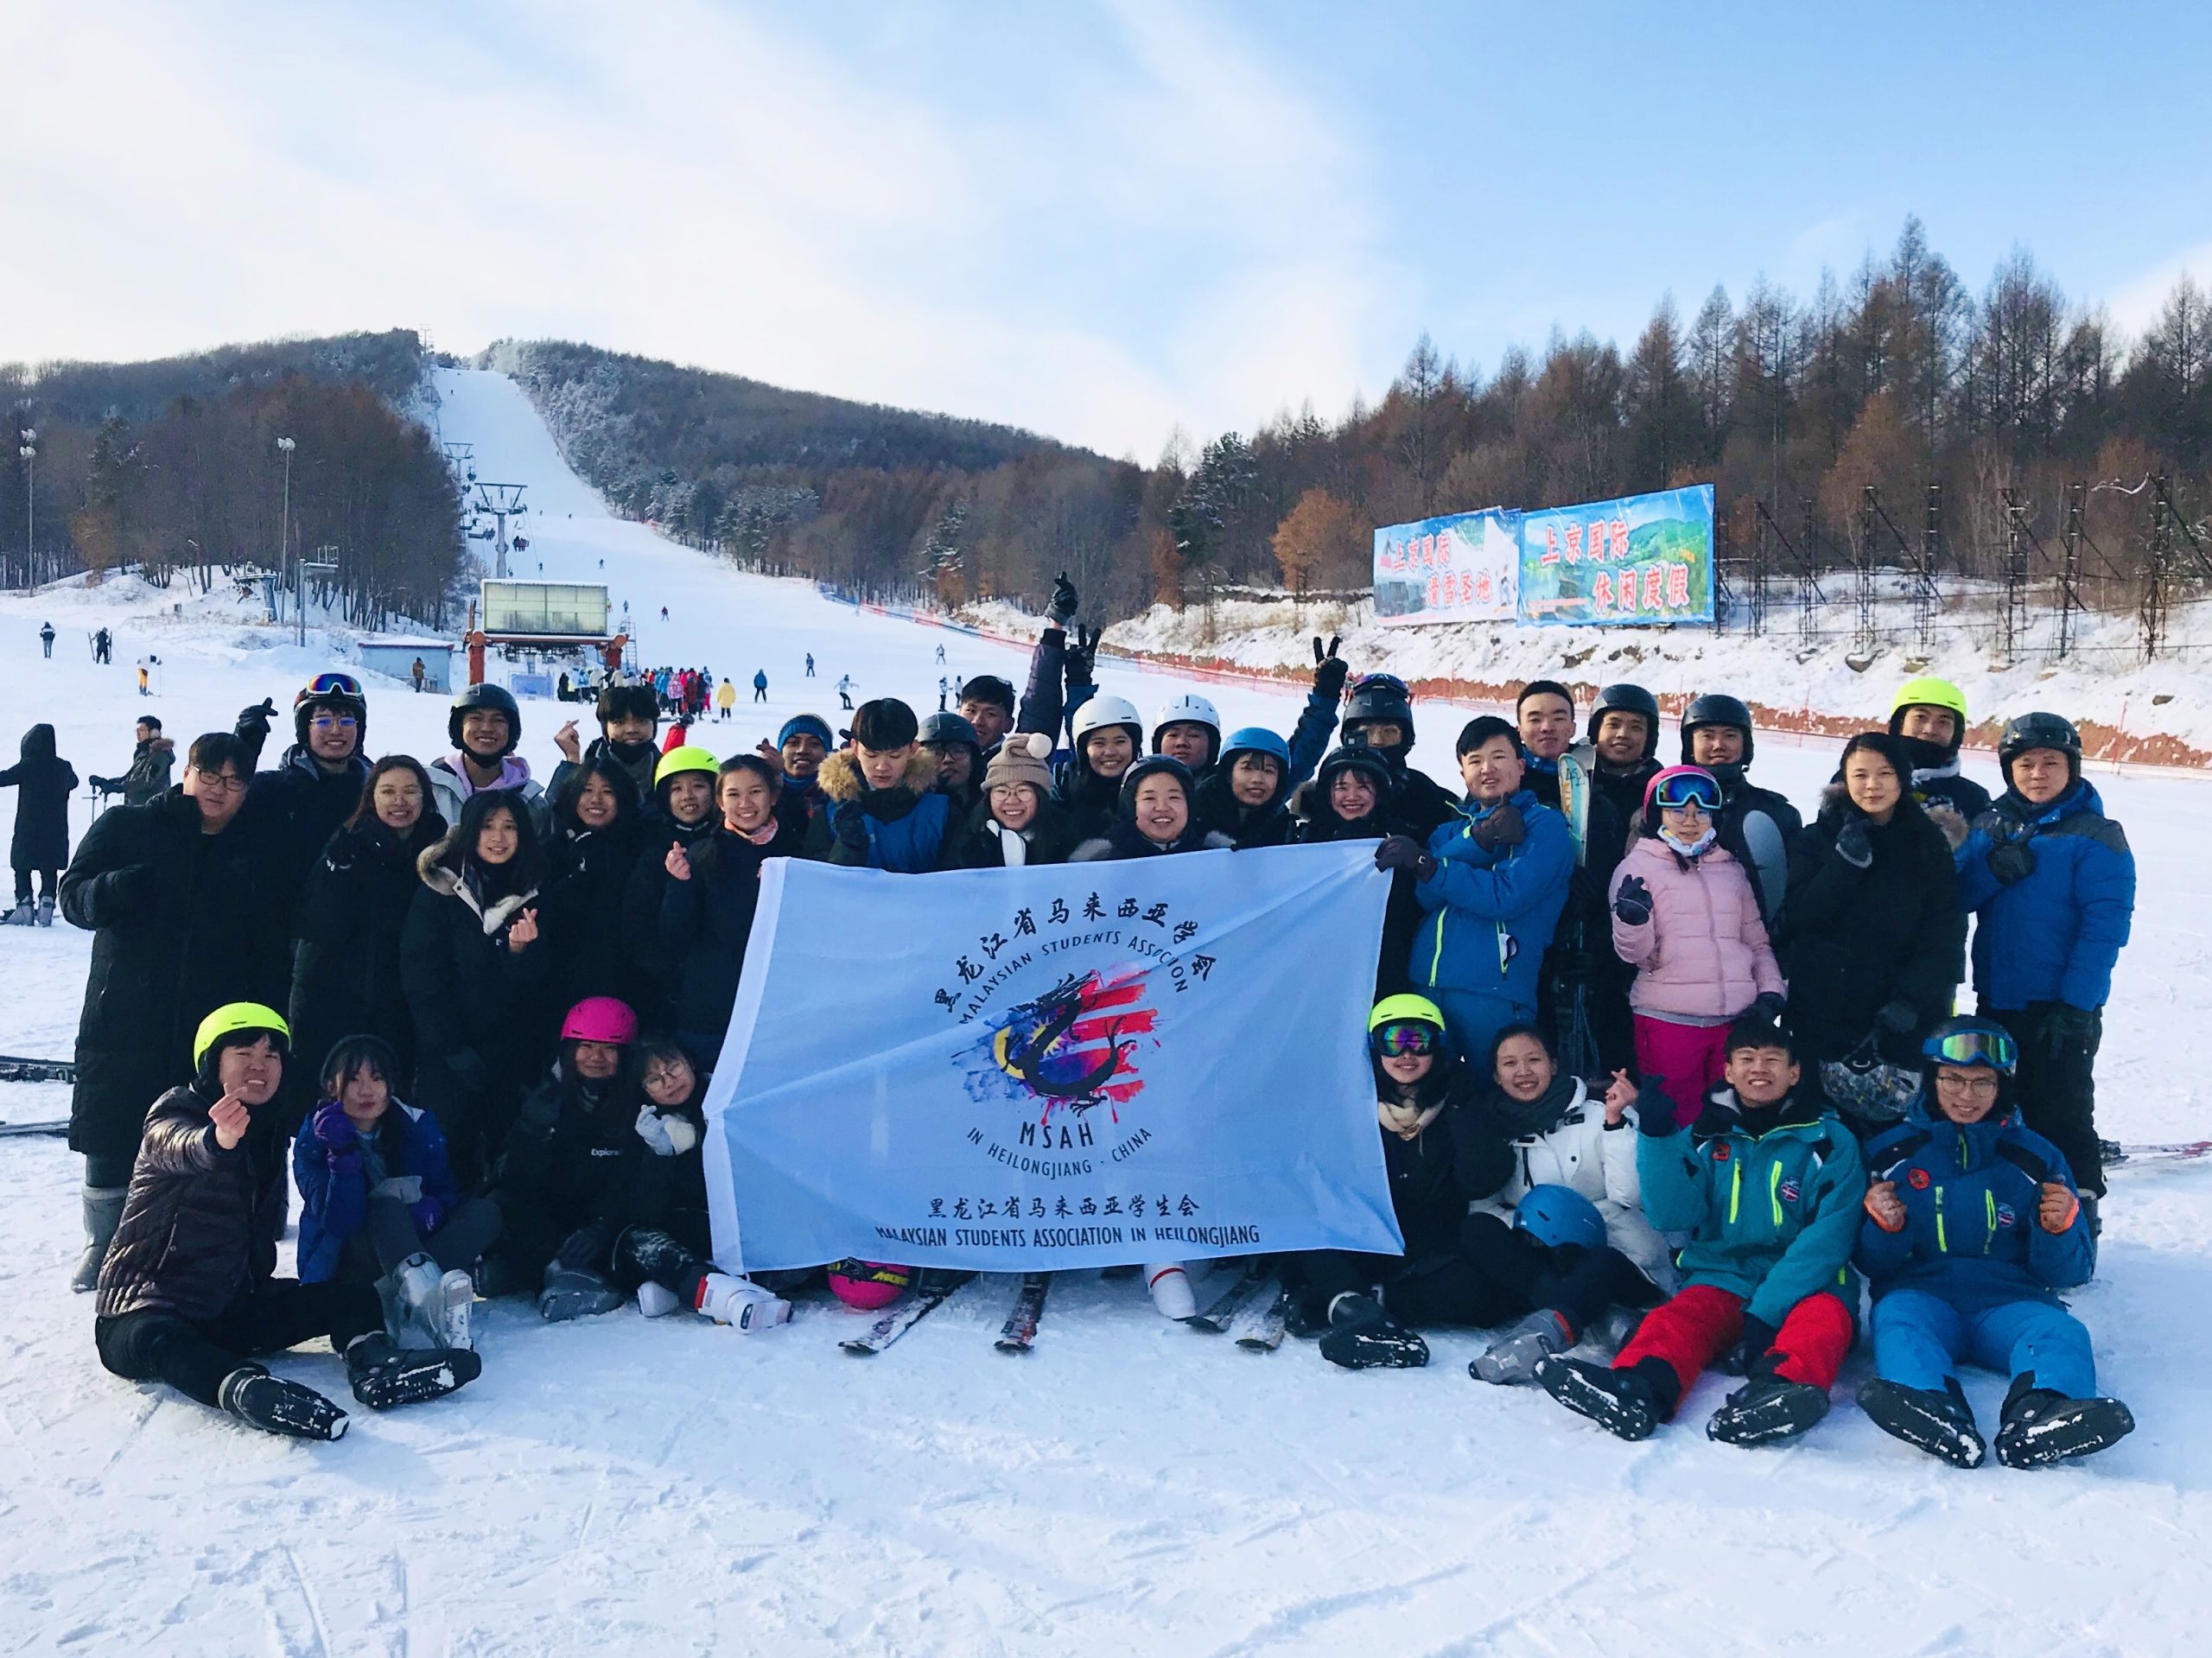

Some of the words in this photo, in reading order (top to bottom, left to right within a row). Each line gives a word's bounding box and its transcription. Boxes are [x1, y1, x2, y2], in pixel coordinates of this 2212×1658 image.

[1392, 532, 1451, 572] 上京国际
[1541, 518, 1630, 566] 上京国际
[1592, 562, 1691, 613] 休闲度假
[959, 952, 1033, 1024] MALAYSIAN
[1041, 930, 1121, 955] STUDENTS
[967, 1127, 983, 1145] IN
[988, 1146, 1092, 1179] HEILONGJIANG
[1111, 1128, 1153, 1161] CHINA
[1020, 1121, 1093, 1149] MSAH
[927, 1194, 1200, 1220] 黑龙江省马来西亚学生会
[874, 1226, 947, 1247] MALAYSIAN
[955, 1227, 1027, 1247] STUDENTS
[1033, 1226, 1122, 1248] ASSOCIATION
[1131, 1226, 1147, 1242] IN
[1155, 1224, 1260, 1248] HEILONGJIANG
